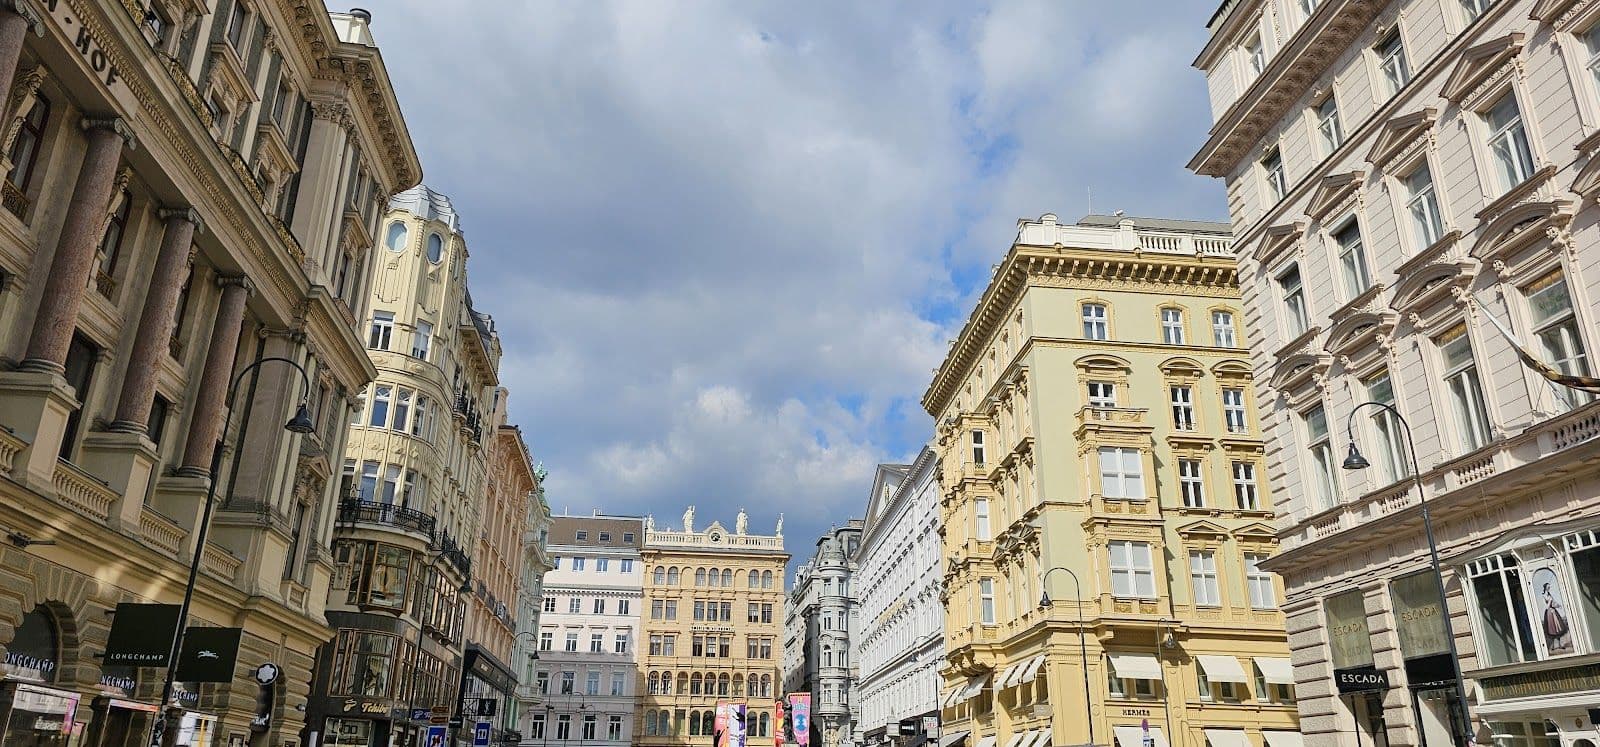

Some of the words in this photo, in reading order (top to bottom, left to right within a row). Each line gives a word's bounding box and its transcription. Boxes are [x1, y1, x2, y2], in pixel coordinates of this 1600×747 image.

[75, 26, 120, 86] HOF
[1402, 606, 1438, 622] ESCADA
[1333, 623, 1363, 636] ESCADA
[4, 651, 54, 672] ONGCHAMP
[110, 653, 164, 661] LONGCHAMP
[100, 675, 135, 690] NGCHAMP
[1340, 673, 1385, 684] ESCADA
